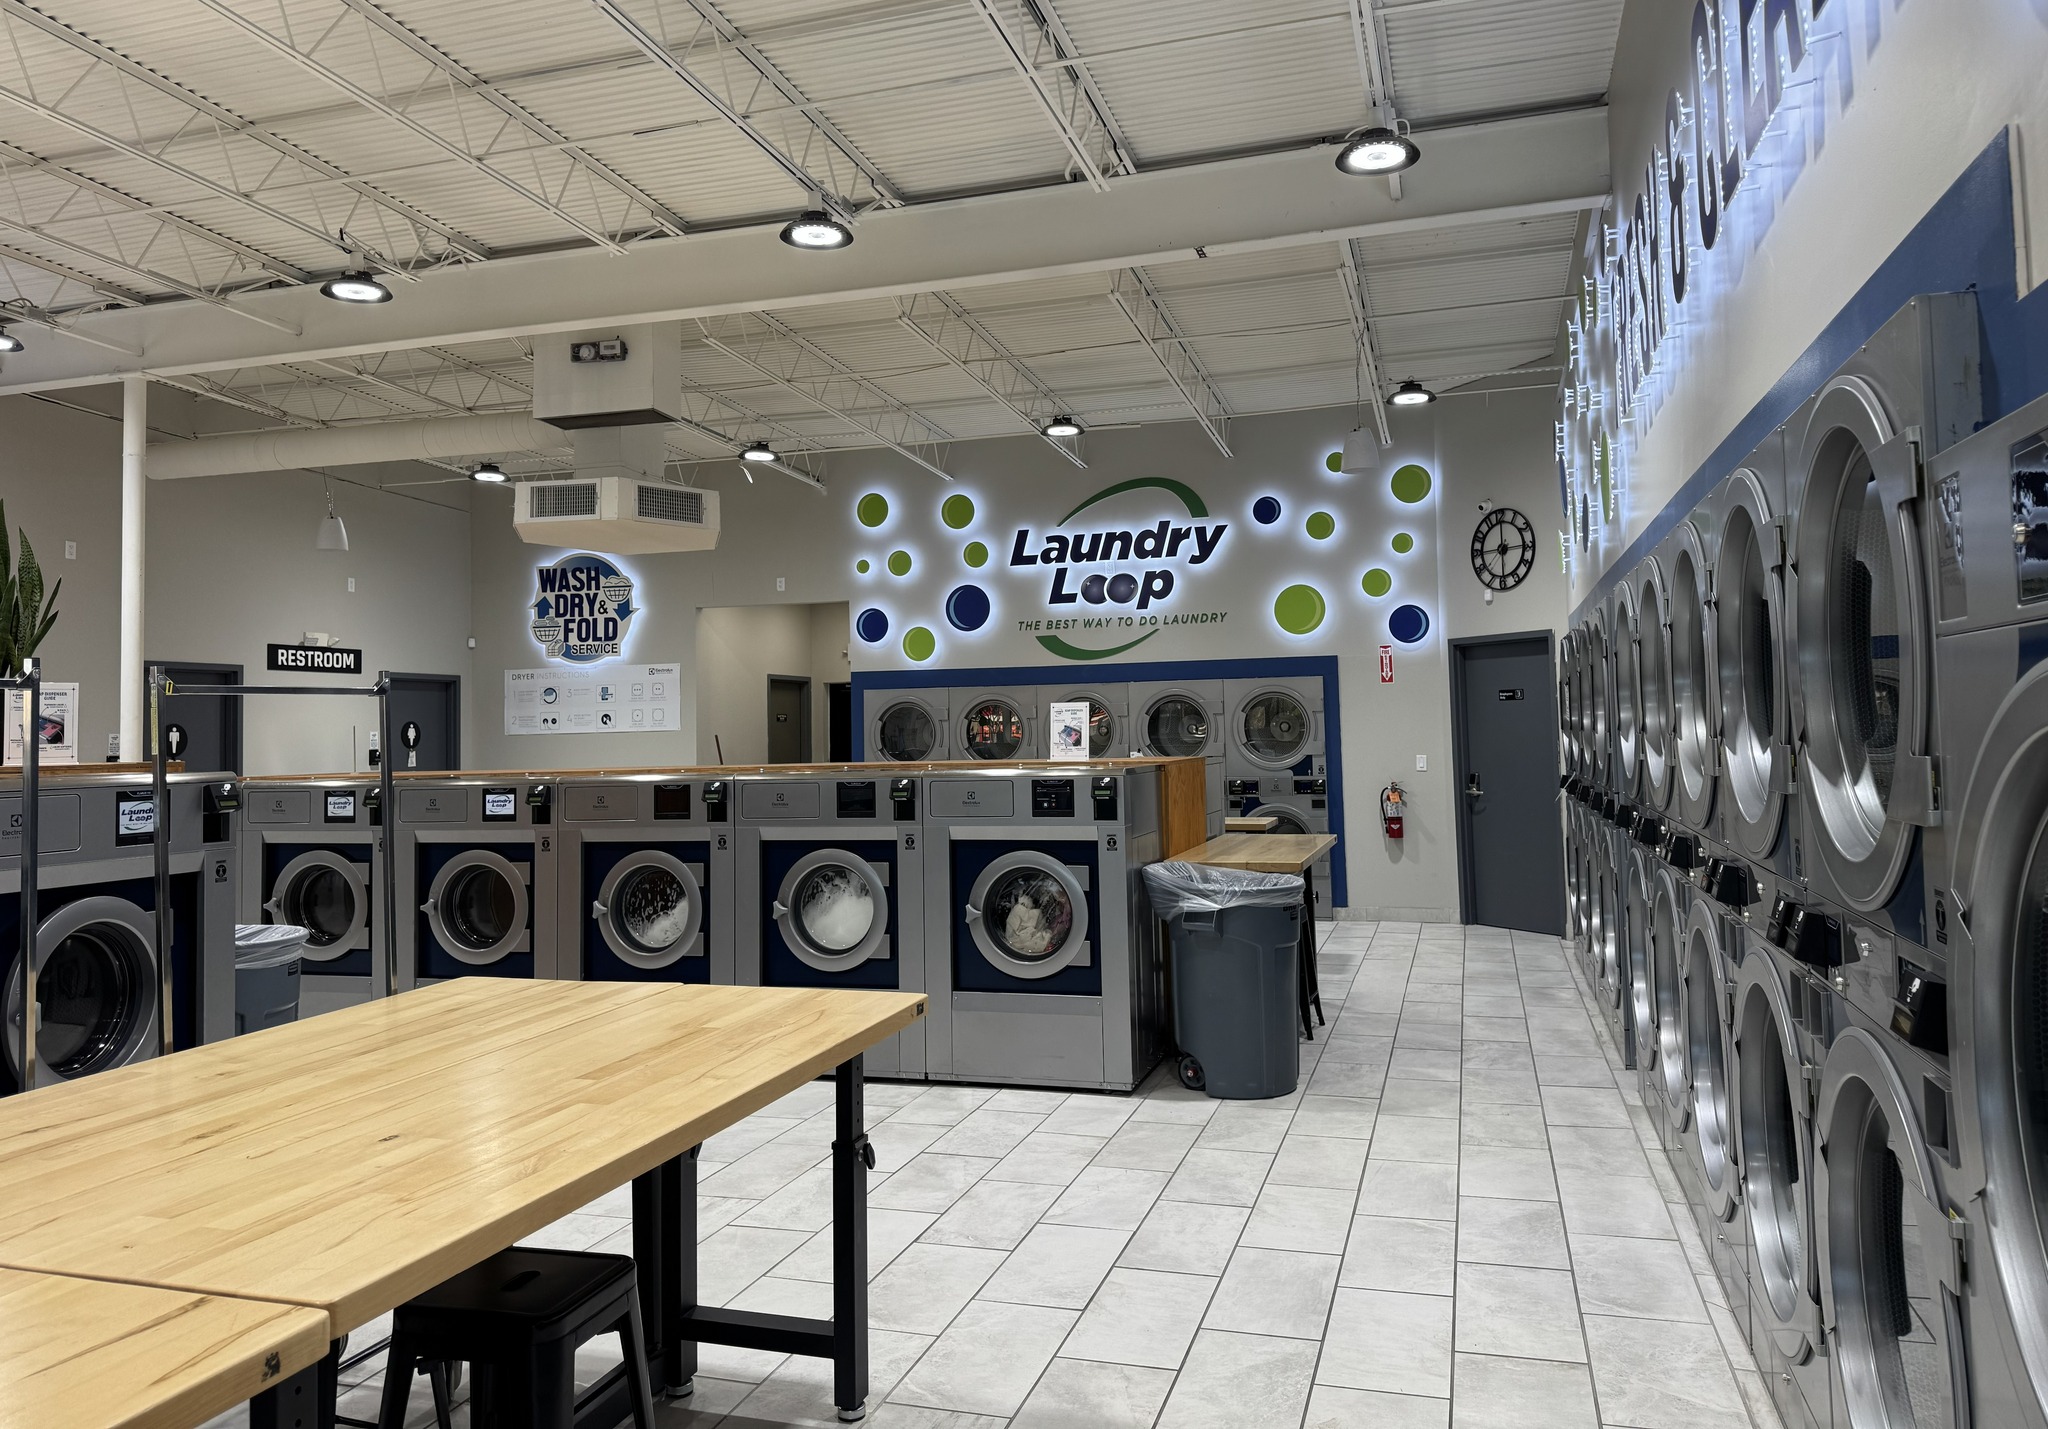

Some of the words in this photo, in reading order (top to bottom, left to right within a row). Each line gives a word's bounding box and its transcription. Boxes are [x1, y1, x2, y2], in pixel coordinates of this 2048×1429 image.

[1665, 87, 1688, 304] &
[1009, 520, 1228, 566] Laundry
[538, 566, 601, 593] WASH
[1048, 567, 1175, 610] Loop
[554, 592, 598, 618] DRY
[598, 600, 608, 615] &
[563, 617, 619, 643] FOLD
[1018, 621, 1041, 631] THE
[1046, 619, 1078, 630] BEST
[1083, 617, 1112, 629] WAY
[1117, 616, 1133, 627] TO
[1139, 615, 1157, 626] DO
[1163, 612, 1228, 625] LAUNDRY
[277, 648, 355, 669] RESTROOM
[571, 643, 618, 655] SERVICE
[511, 673, 535, 681] DRYER
[537, 671, 590, 680] INSTRUCTIONS
[121, 807, 153, 816] Laund
